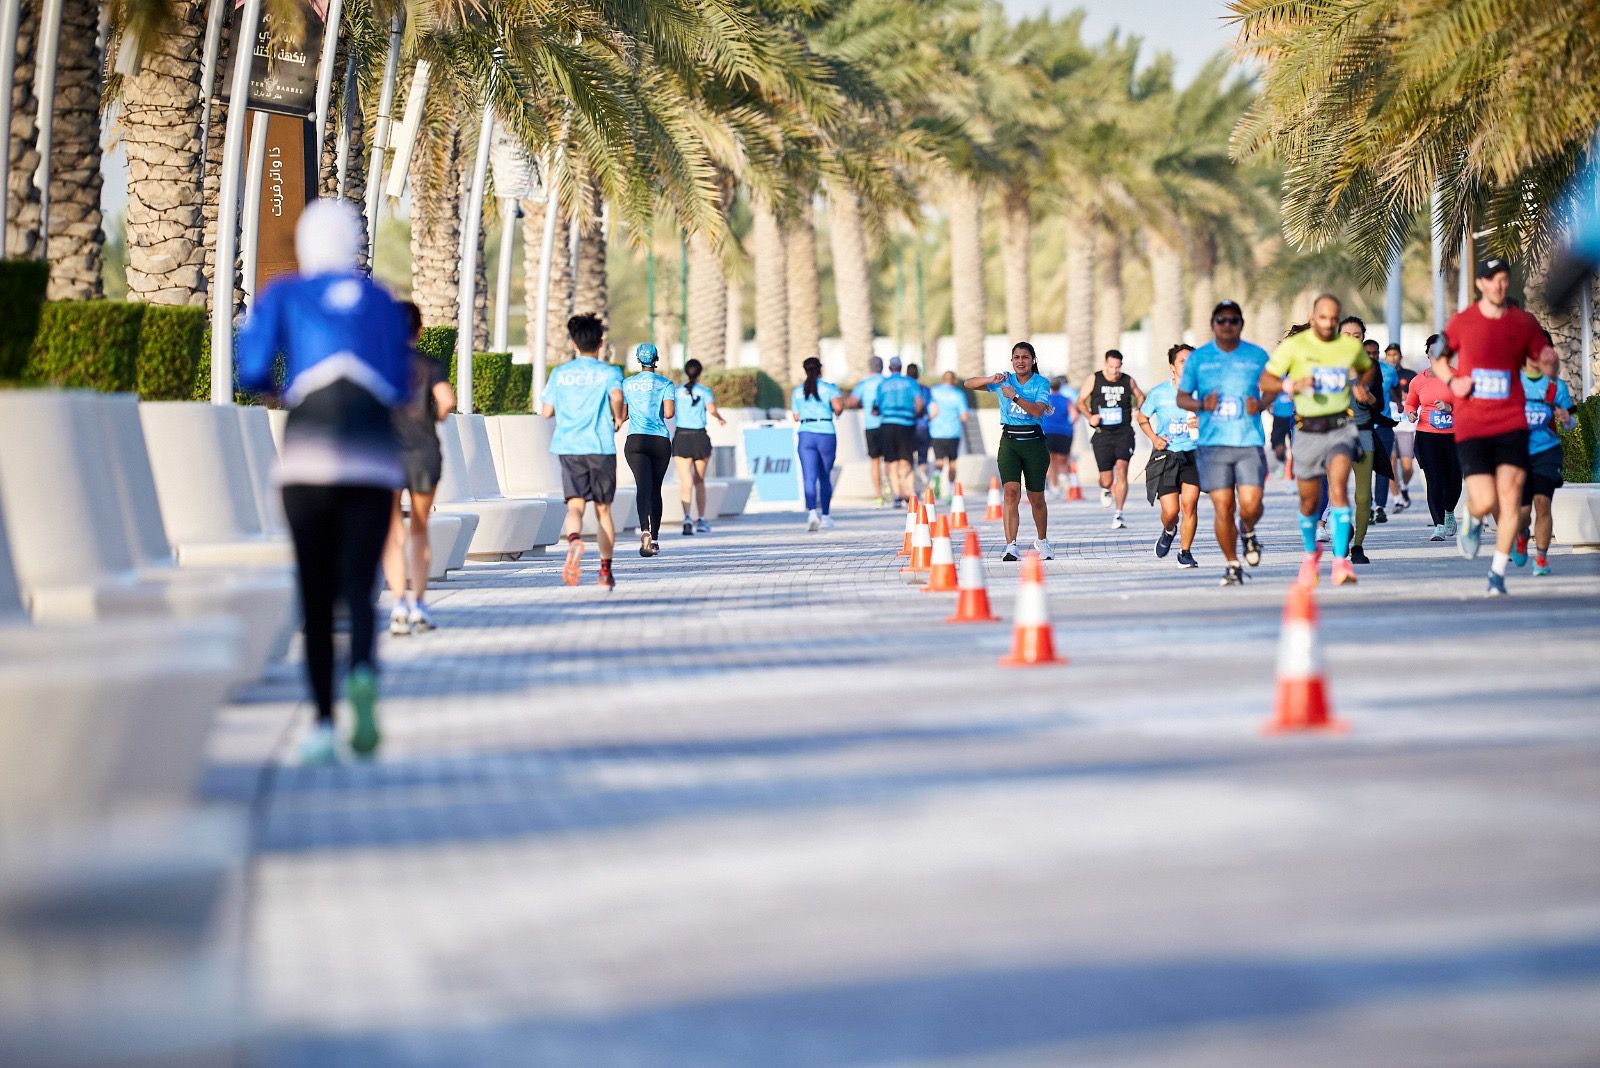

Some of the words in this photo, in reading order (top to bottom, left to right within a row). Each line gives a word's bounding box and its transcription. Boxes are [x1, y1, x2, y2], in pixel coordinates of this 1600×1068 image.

[626, 382, 654, 392] ADCB
[1433, 414, 1453, 425] 542
[752, 457, 760, 475] 1
[763, 456, 791, 474] km
